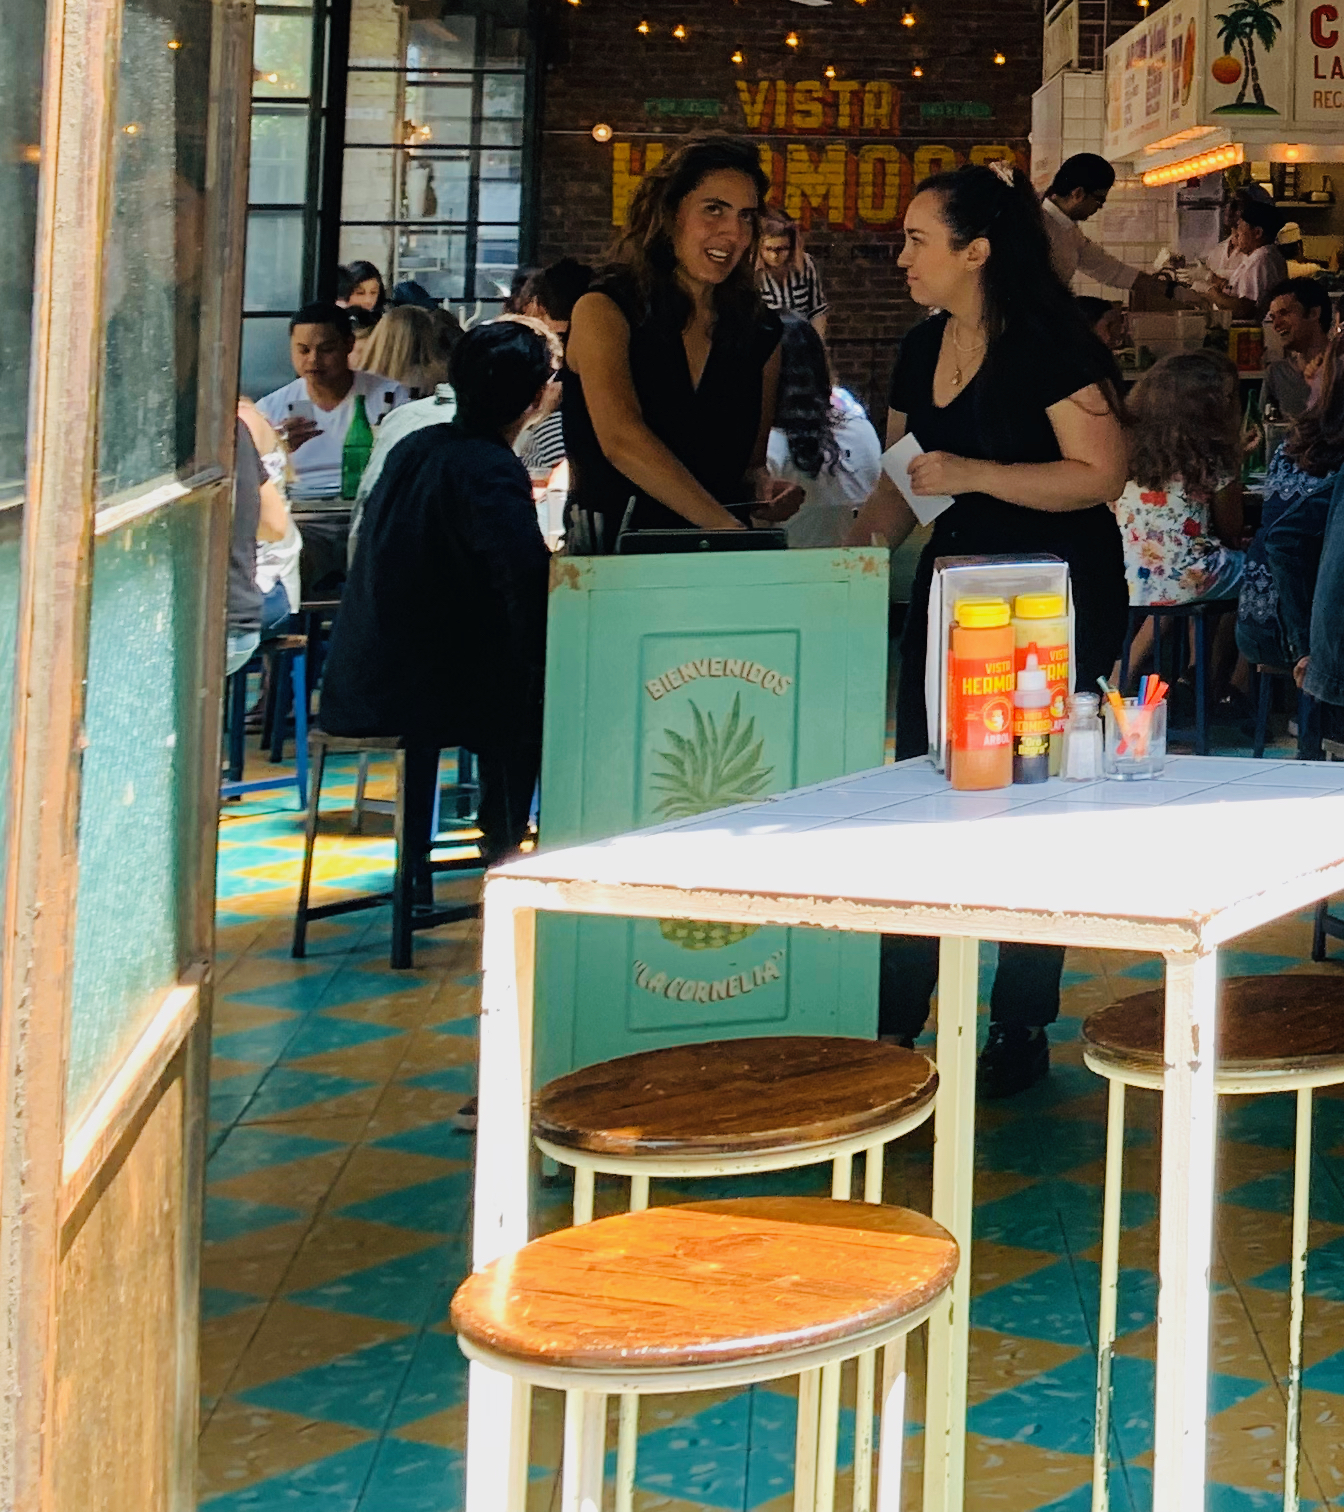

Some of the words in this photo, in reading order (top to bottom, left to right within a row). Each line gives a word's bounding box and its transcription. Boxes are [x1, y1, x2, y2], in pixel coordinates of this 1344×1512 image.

[1313, 55, 1344, 80] LA
[735, 79, 898, 133] VISTA
[645, 657, 793, 701] BIENVENIDOS
